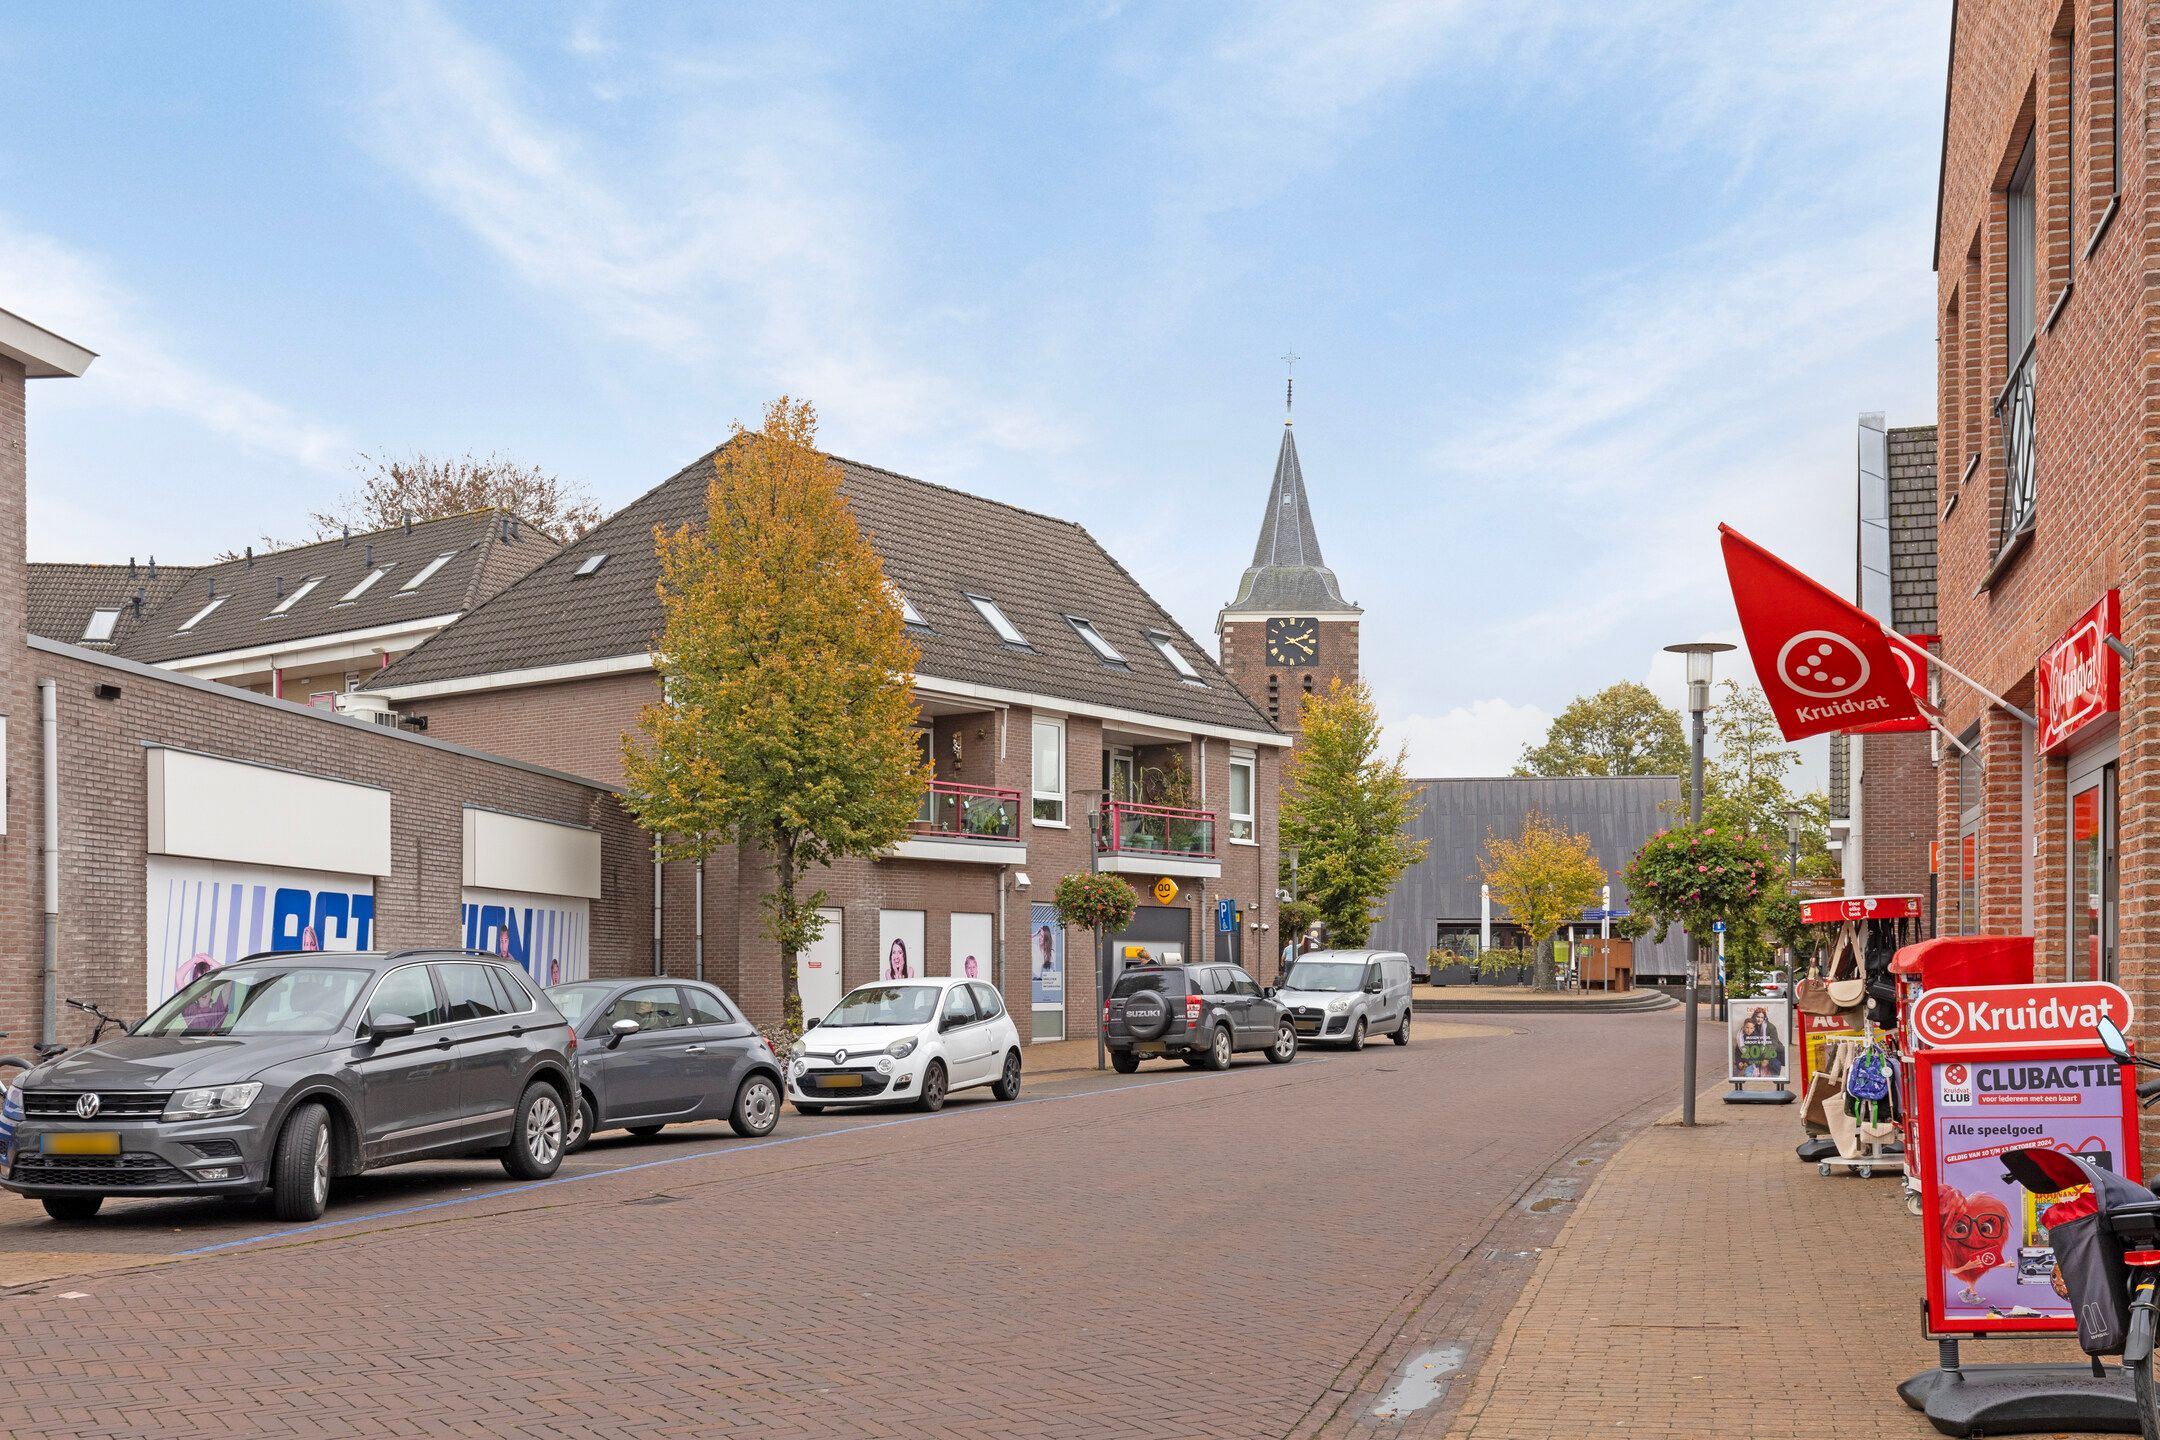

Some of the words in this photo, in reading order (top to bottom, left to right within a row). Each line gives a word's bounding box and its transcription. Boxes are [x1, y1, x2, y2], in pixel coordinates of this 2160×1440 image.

[2058, 646, 2096, 705] Kruidvat
[1796, 695, 1890, 724] Kruidvat
[1126, 1010, 1161, 1018] SUZUKI
[1967, 998, 2113, 1031] Kruidvat
[1976, 1064, 2121, 1092] CLUBACTIE
[1943, 1094, 1970, 1103] CLUB
[1998, 1093, 2028, 1102] iedereen
[2058, 1092, 2078, 1101] kaart
[1948, 1124, 1974, 1135] Alle
[1977, 1123, 2043, 1137] speelgoed
[1947, 1154, 1968, 1162] GELDIG
[1990, 1147, 2001, 1156] T/M
[2009, 1142, 2037, 1151] OKTOBER
[2036, 1138, 2053, 1147] 2024
[2091, 1332, 2108, 1340] BASIL
